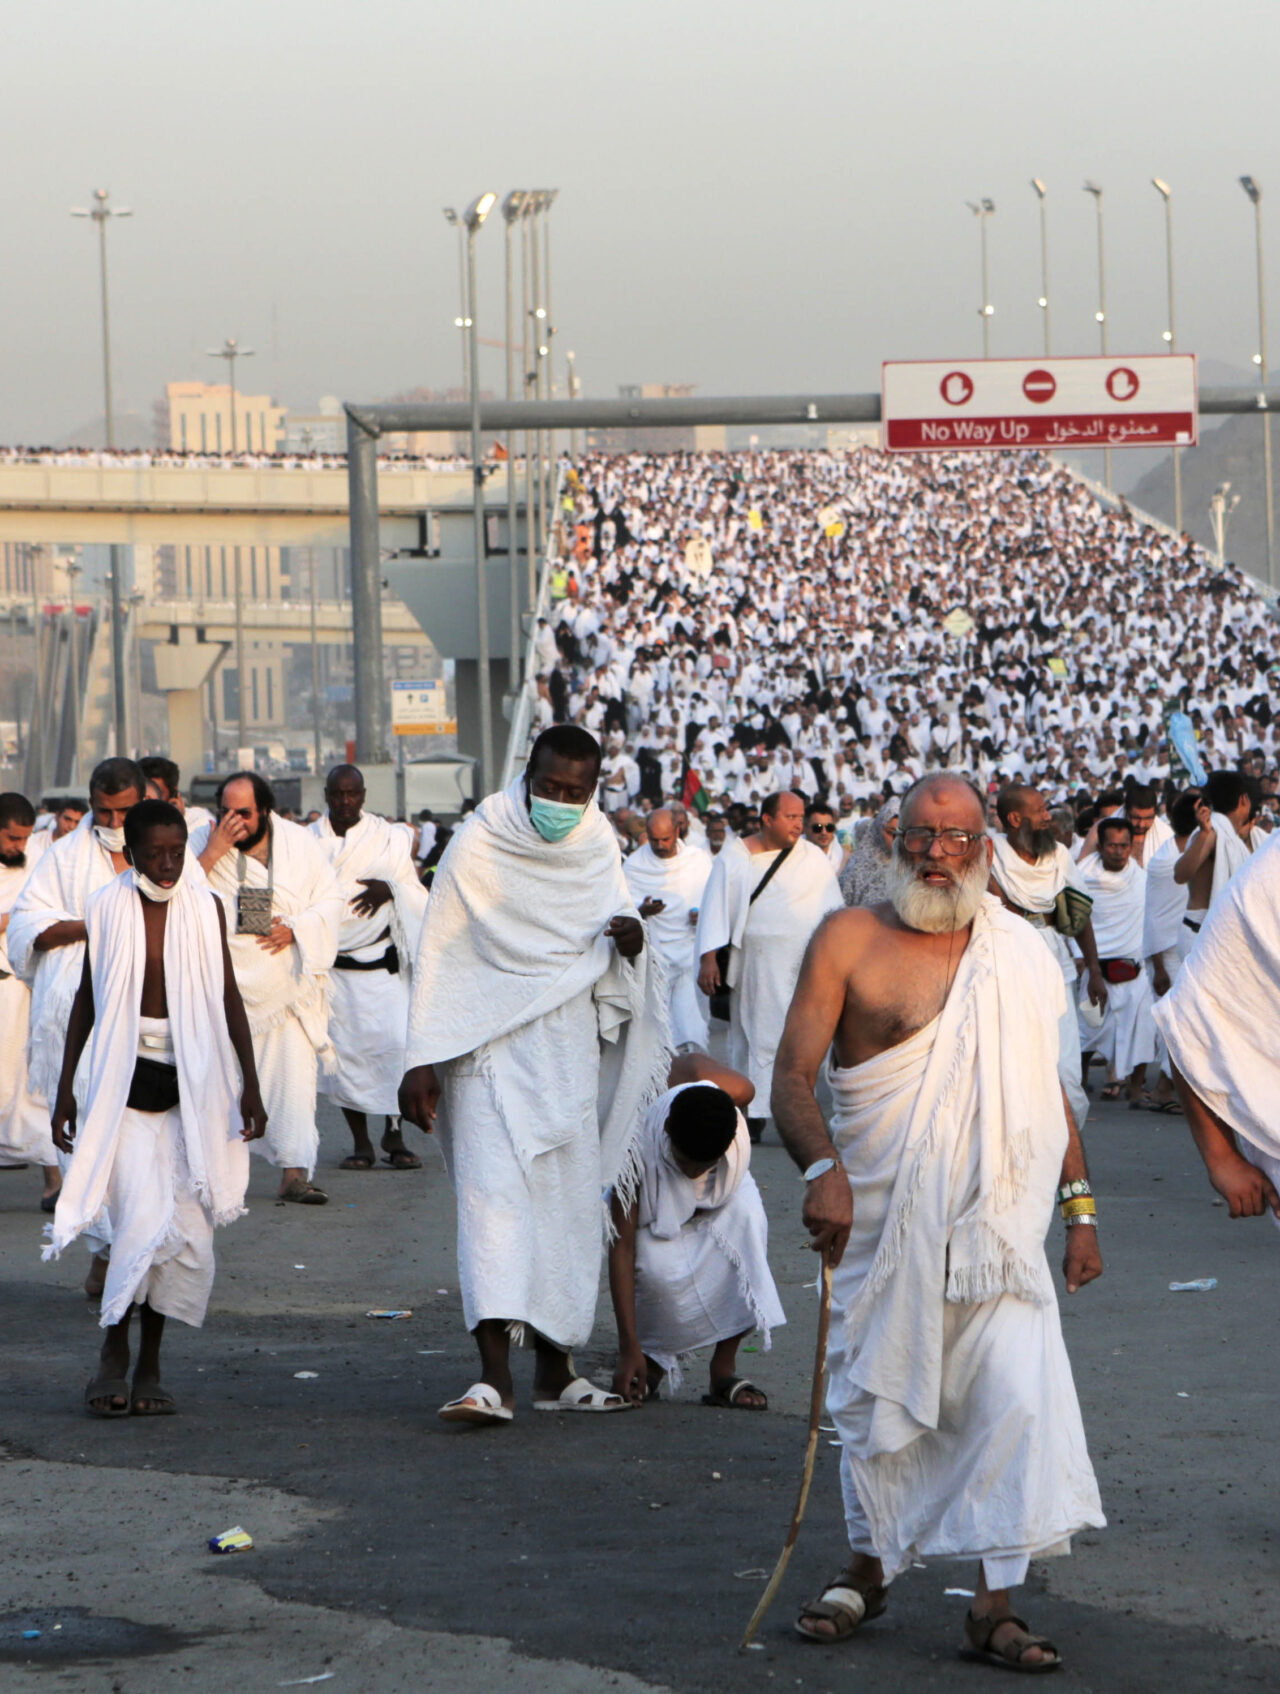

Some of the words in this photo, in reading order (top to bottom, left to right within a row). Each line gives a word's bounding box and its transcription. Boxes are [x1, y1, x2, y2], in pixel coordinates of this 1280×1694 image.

[921, 422, 950, 441] No
[952, 421, 996, 444] Way
[1000, 419, 1030, 443] Up
[1044, 418, 1104, 442] الدخول
[1107, 418, 1158, 444] ممنوع
